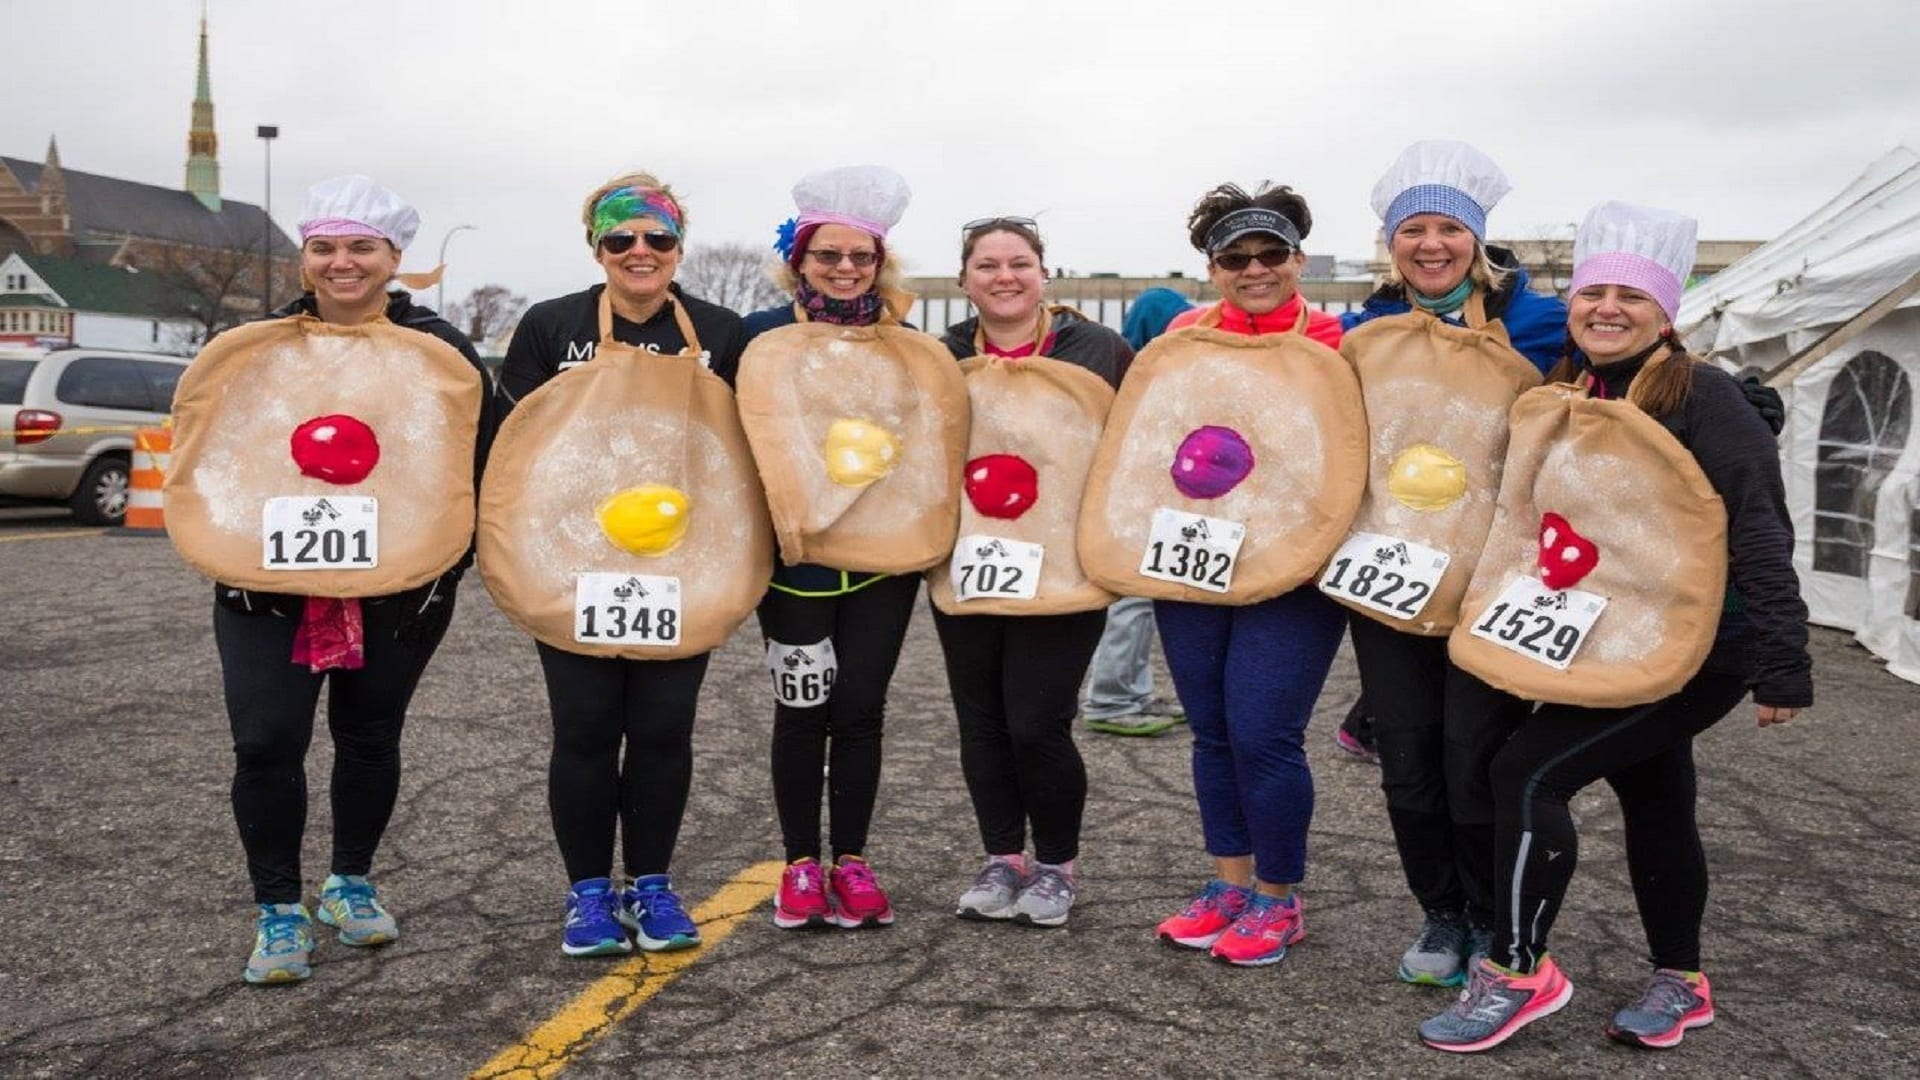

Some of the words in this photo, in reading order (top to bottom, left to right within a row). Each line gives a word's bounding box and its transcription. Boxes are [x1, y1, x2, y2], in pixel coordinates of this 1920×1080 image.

[269, 529, 372, 563] 1201
[1147, 541, 1231, 587] 1382
[960, 564, 1023, 596] 702
[1326, 558, 1430, 615] 1822
[581, 605, 676, 640] 1348
[1477, 602, 1580, 662] 1529
